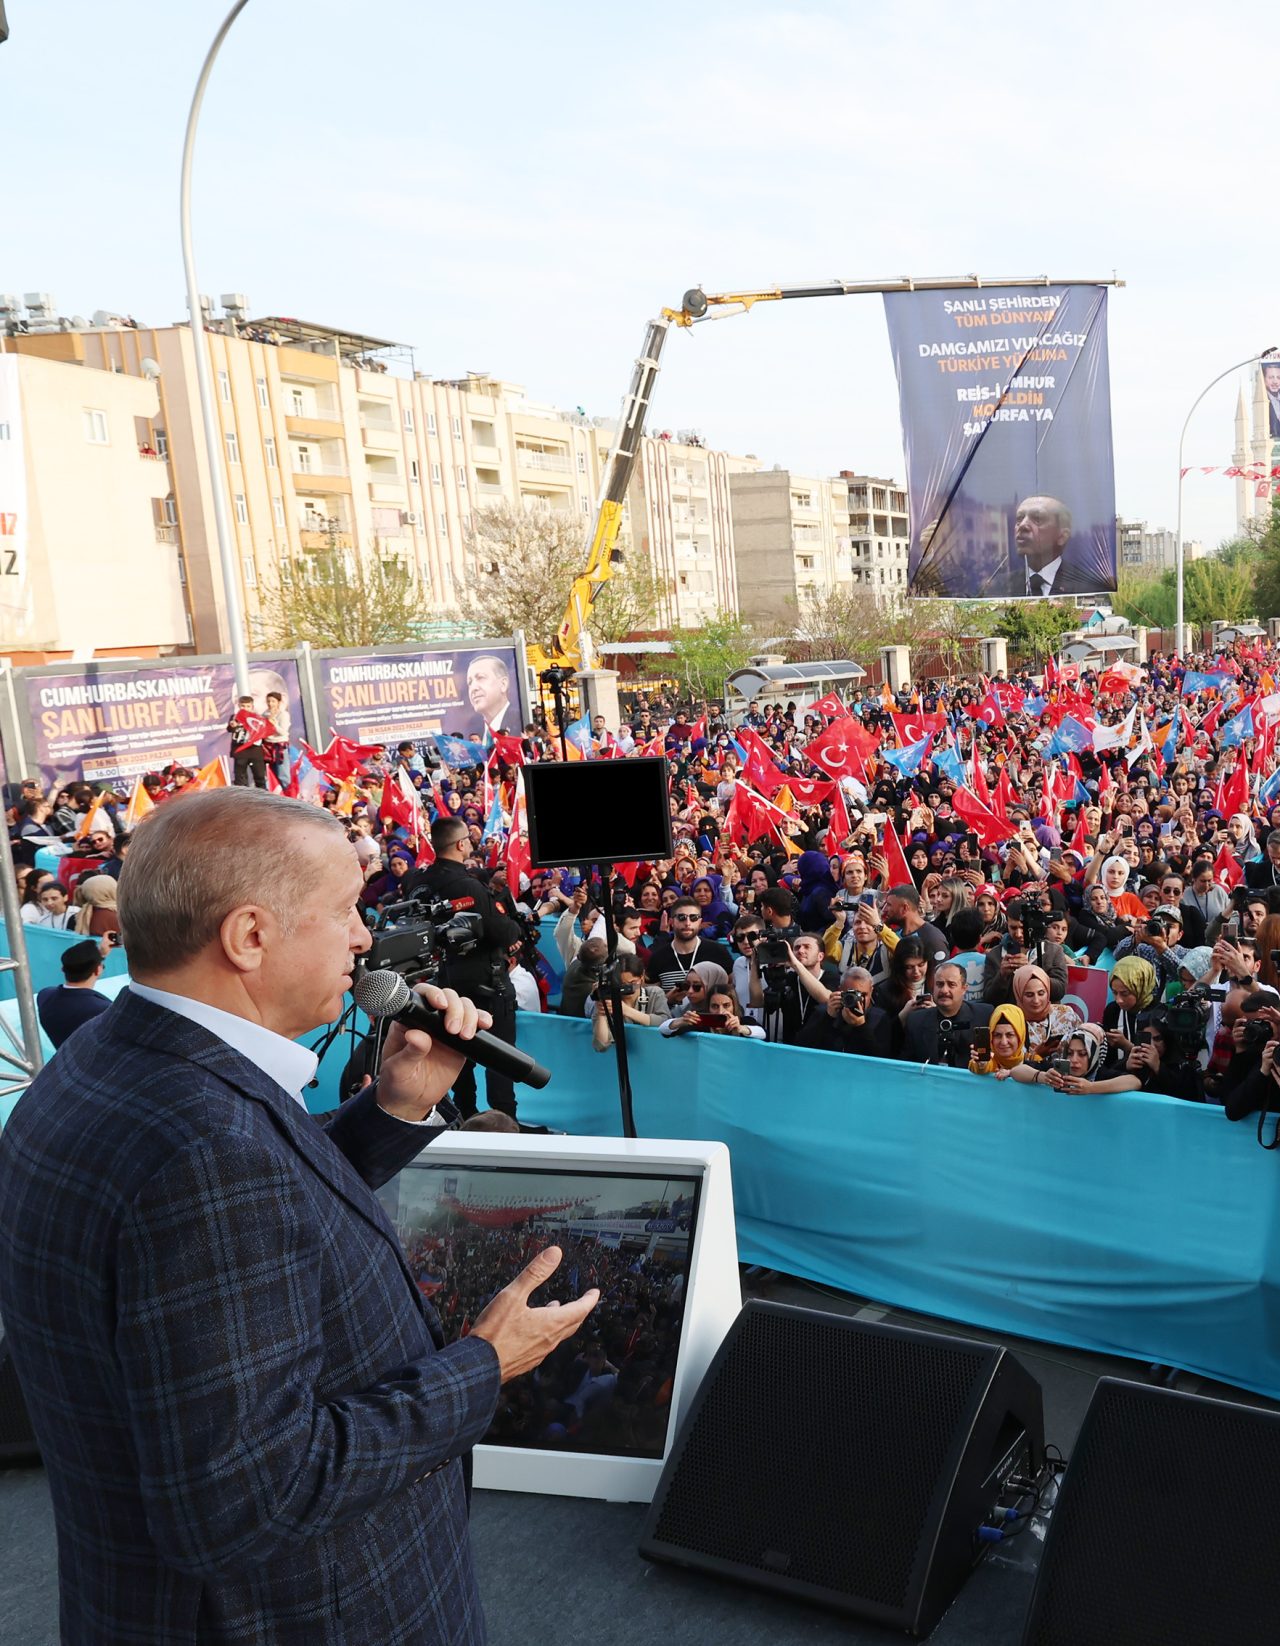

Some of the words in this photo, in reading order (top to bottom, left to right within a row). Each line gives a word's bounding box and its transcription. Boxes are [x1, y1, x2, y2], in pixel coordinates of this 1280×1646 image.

[943, 299, 986, 315] ŞANLI
[989, 295, 1061, 311] ŞEHİRDEN
[954, 313, 988, 328] TÜM
[919, 337, 1010, 358] DAMGAMIZI
[938, 355, 1000, 374] TÜRKİYE
[330, 660, 454, 684] CUMHURBAŞKANIMIZ
[40, 675, 214, 708] CUMHURBAŞKANIMIZ
[331, 677, 458, 710] ŞANLIURFA'DA
[41, 696, 220, 740] ŞANLIURFA'DA
[95, 768, 117, 778] 16.00
[422, 935, 429, 945] 3
